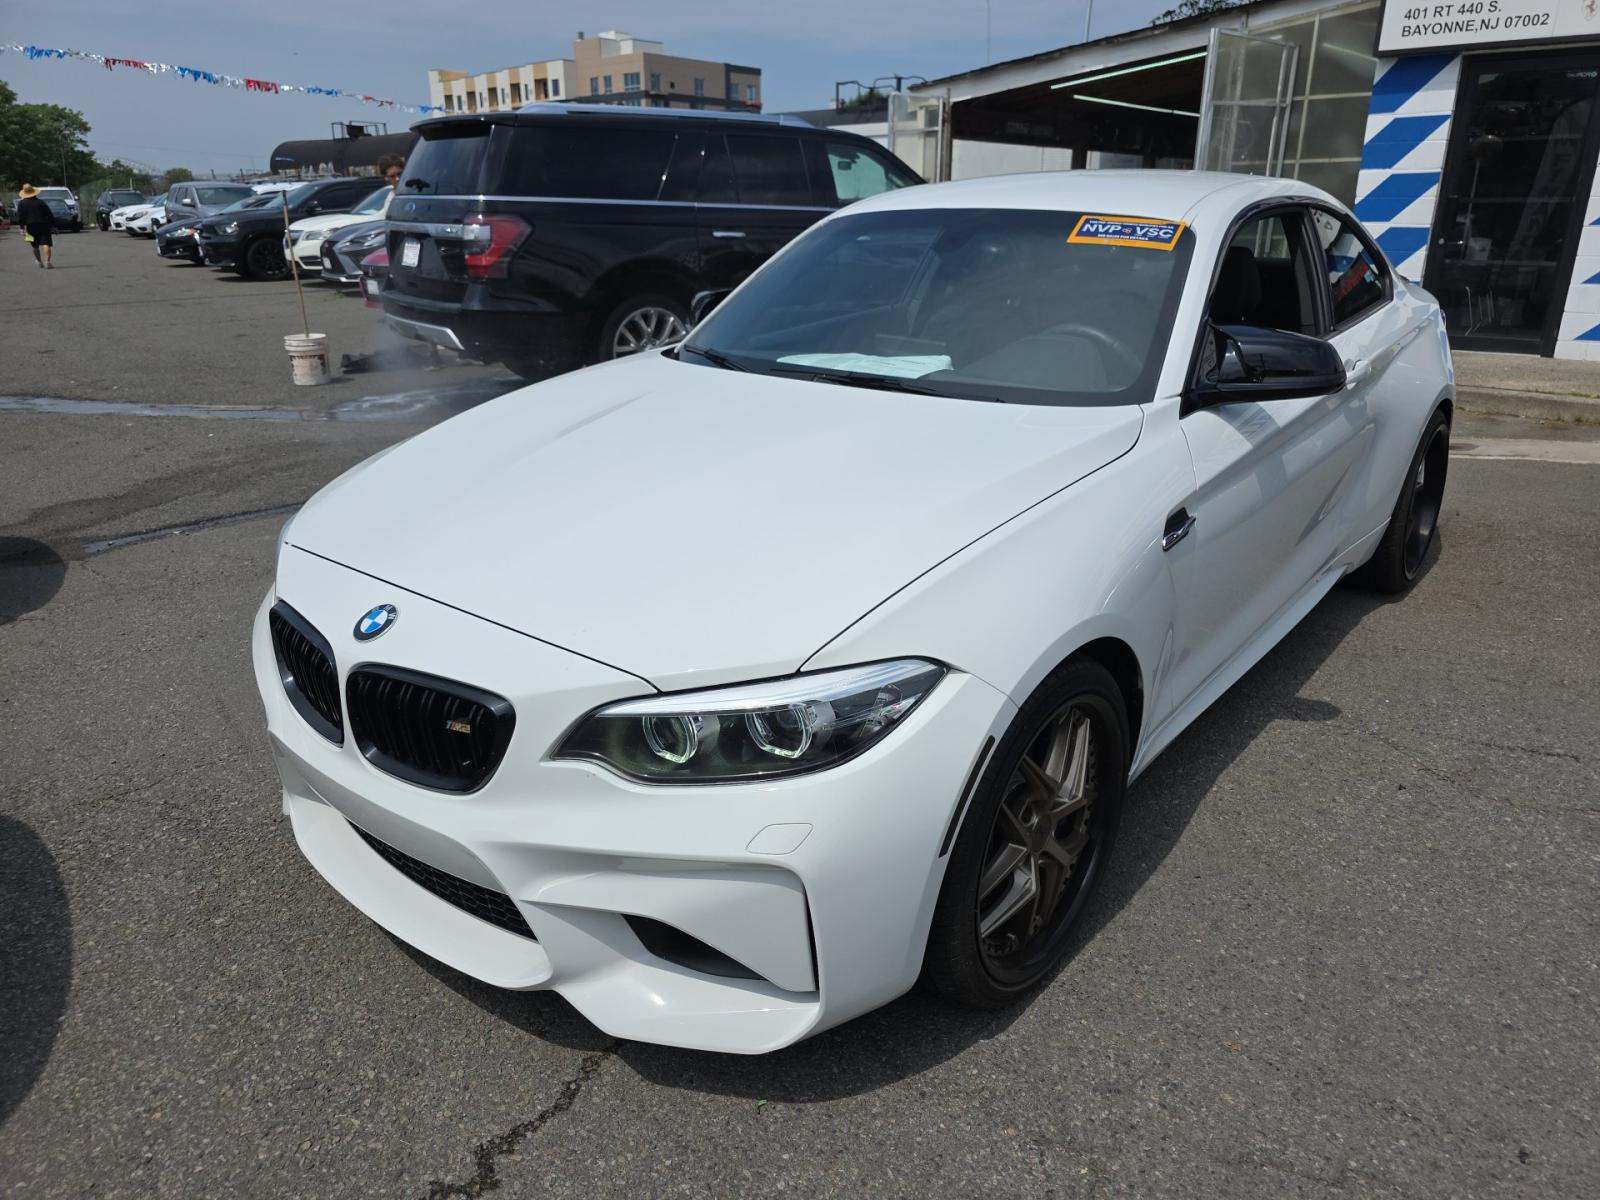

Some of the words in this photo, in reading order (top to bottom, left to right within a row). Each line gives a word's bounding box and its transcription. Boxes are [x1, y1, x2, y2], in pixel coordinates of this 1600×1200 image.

[1404, 7, 1428, 20] 401
[1433, 5, 1455, 18] RT
[1457, 2, 1484, 15] 440
[1488, 0, 1501, 13] S.
[1504, 13, 1550, 29] 07002
[1082, 222, 1122, 234] NVP
[1136, 226, 1174, 237] VSC
